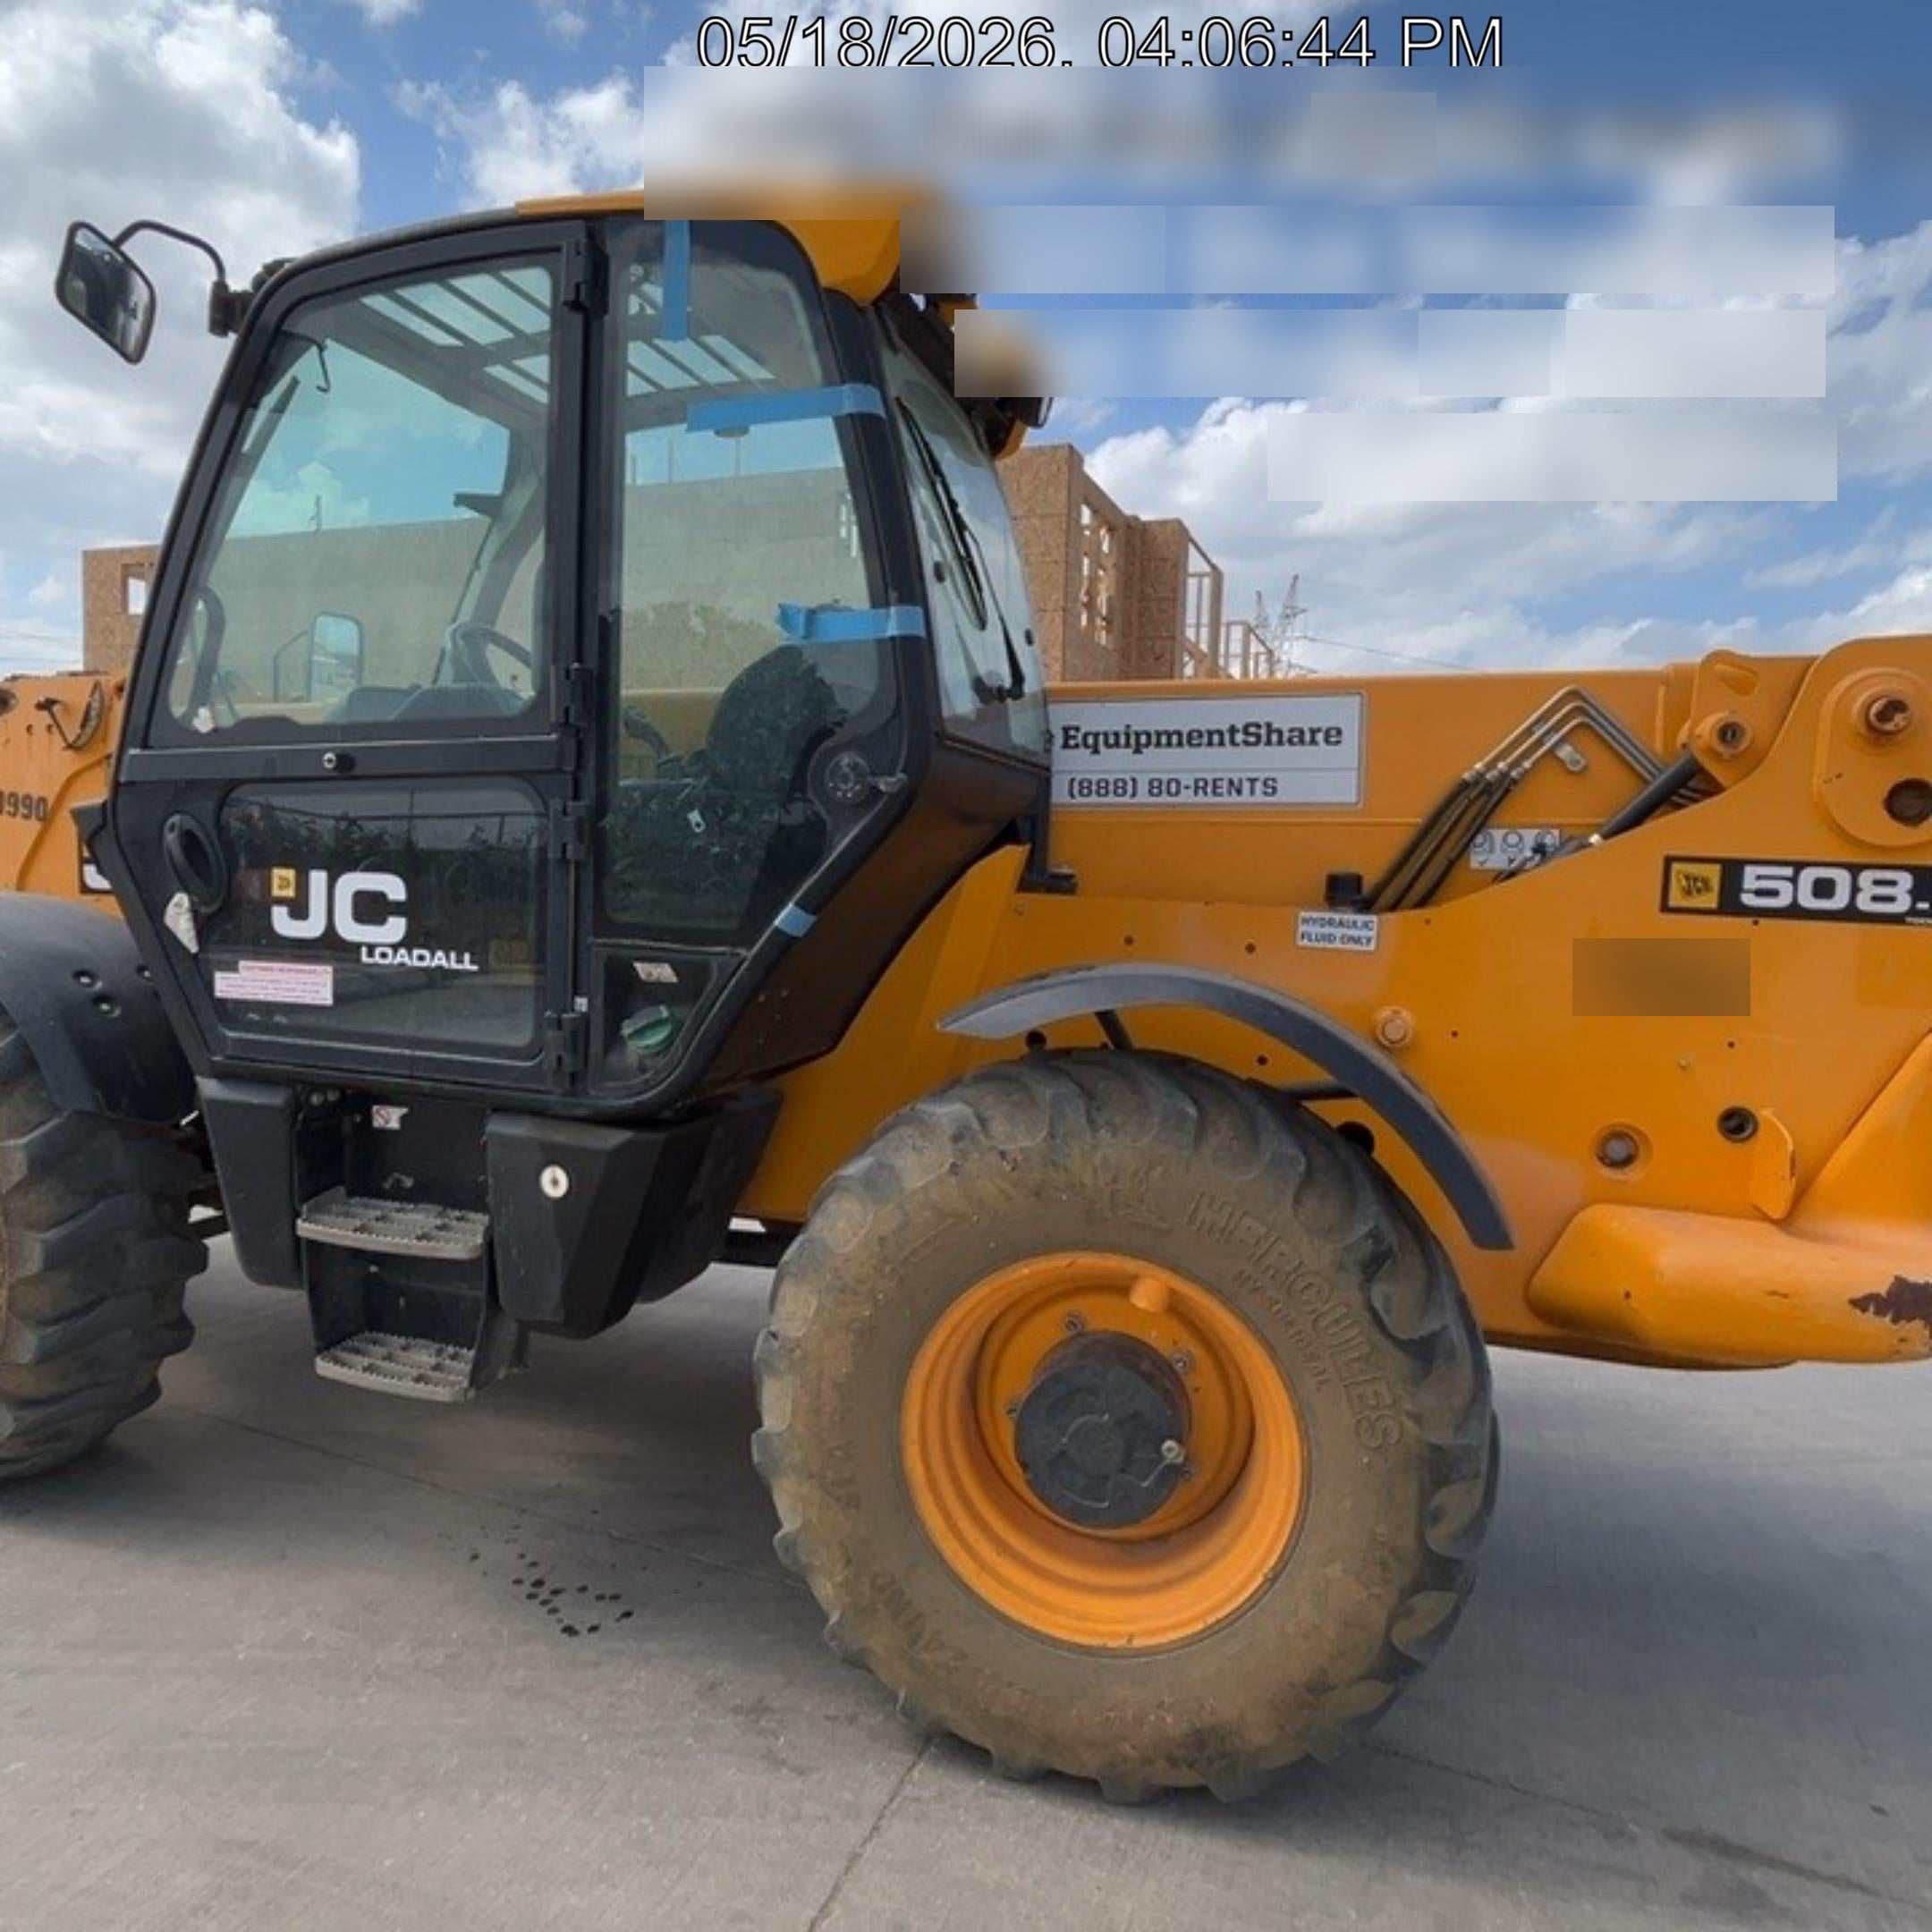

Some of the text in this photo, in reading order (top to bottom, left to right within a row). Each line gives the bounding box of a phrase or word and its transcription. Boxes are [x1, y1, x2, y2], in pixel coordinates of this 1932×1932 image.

[1060, 721, 1343, 755] EquipmentShare
[1067, 776, 1279, 801] (888) 80-RENTS
[1301, 916, 1375, 931] HYDRAULIC
[1301, 931, 1373, 946] FLUID ONLY
[360, 945, 479, 971] LOADALL
[1186, 1191, 1403, 1449] HERCULES
